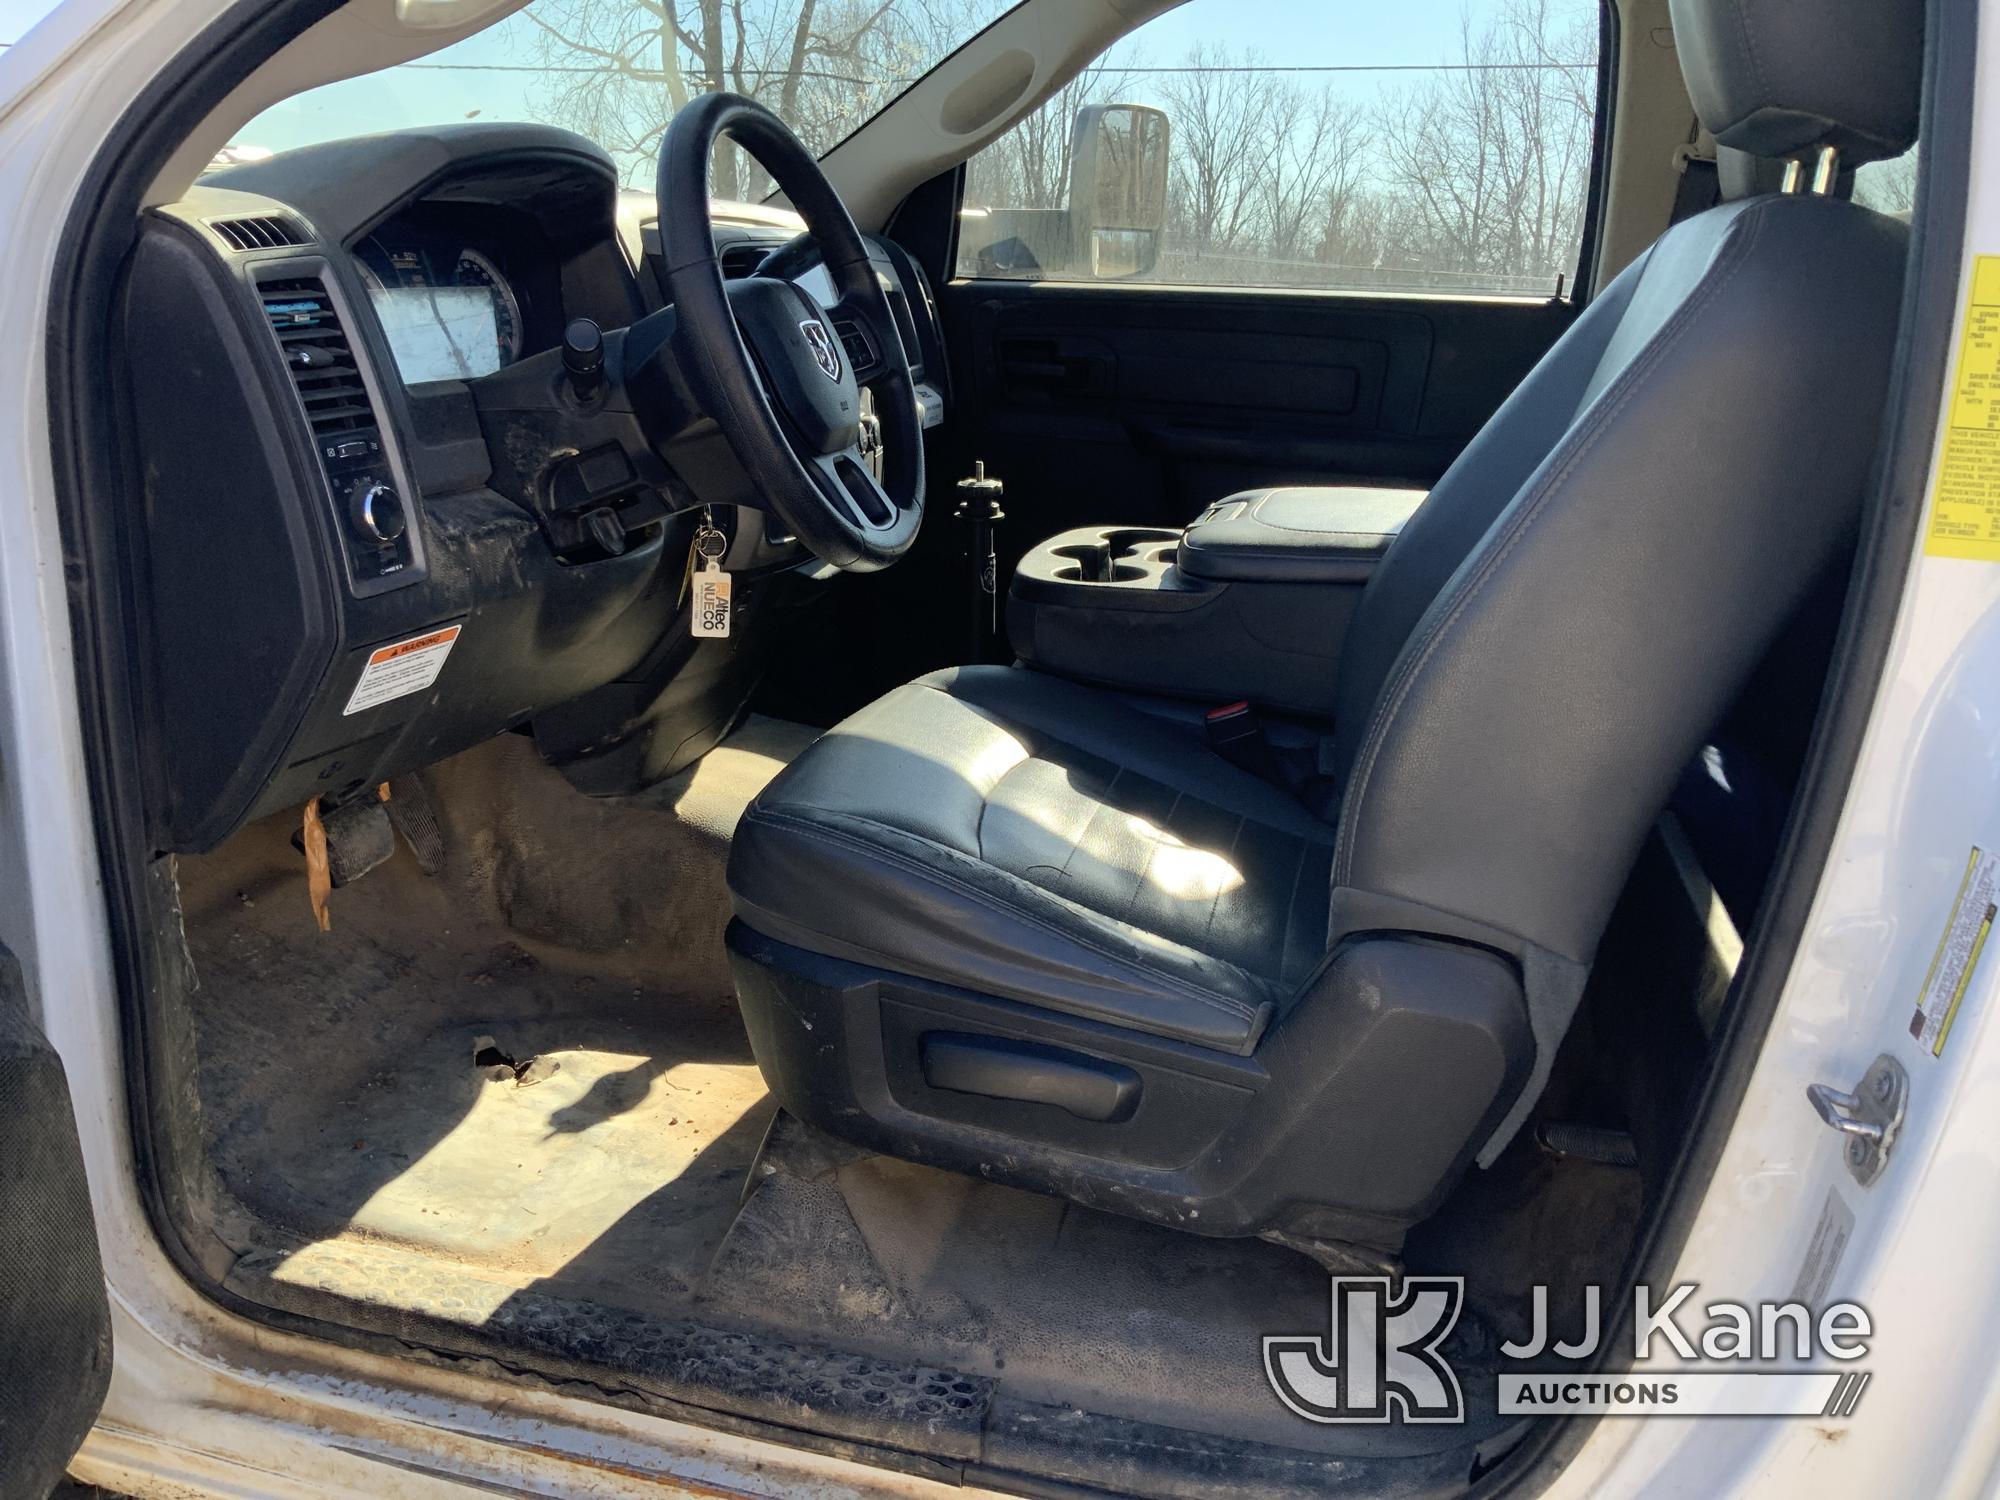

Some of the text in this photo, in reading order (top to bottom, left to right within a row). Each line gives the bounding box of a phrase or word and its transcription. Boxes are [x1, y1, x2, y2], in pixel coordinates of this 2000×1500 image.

[703, 582, 715, 630] NUECO
[715, 596, 729, 630] Altec
[402, 635, 440, 652] WARNING
